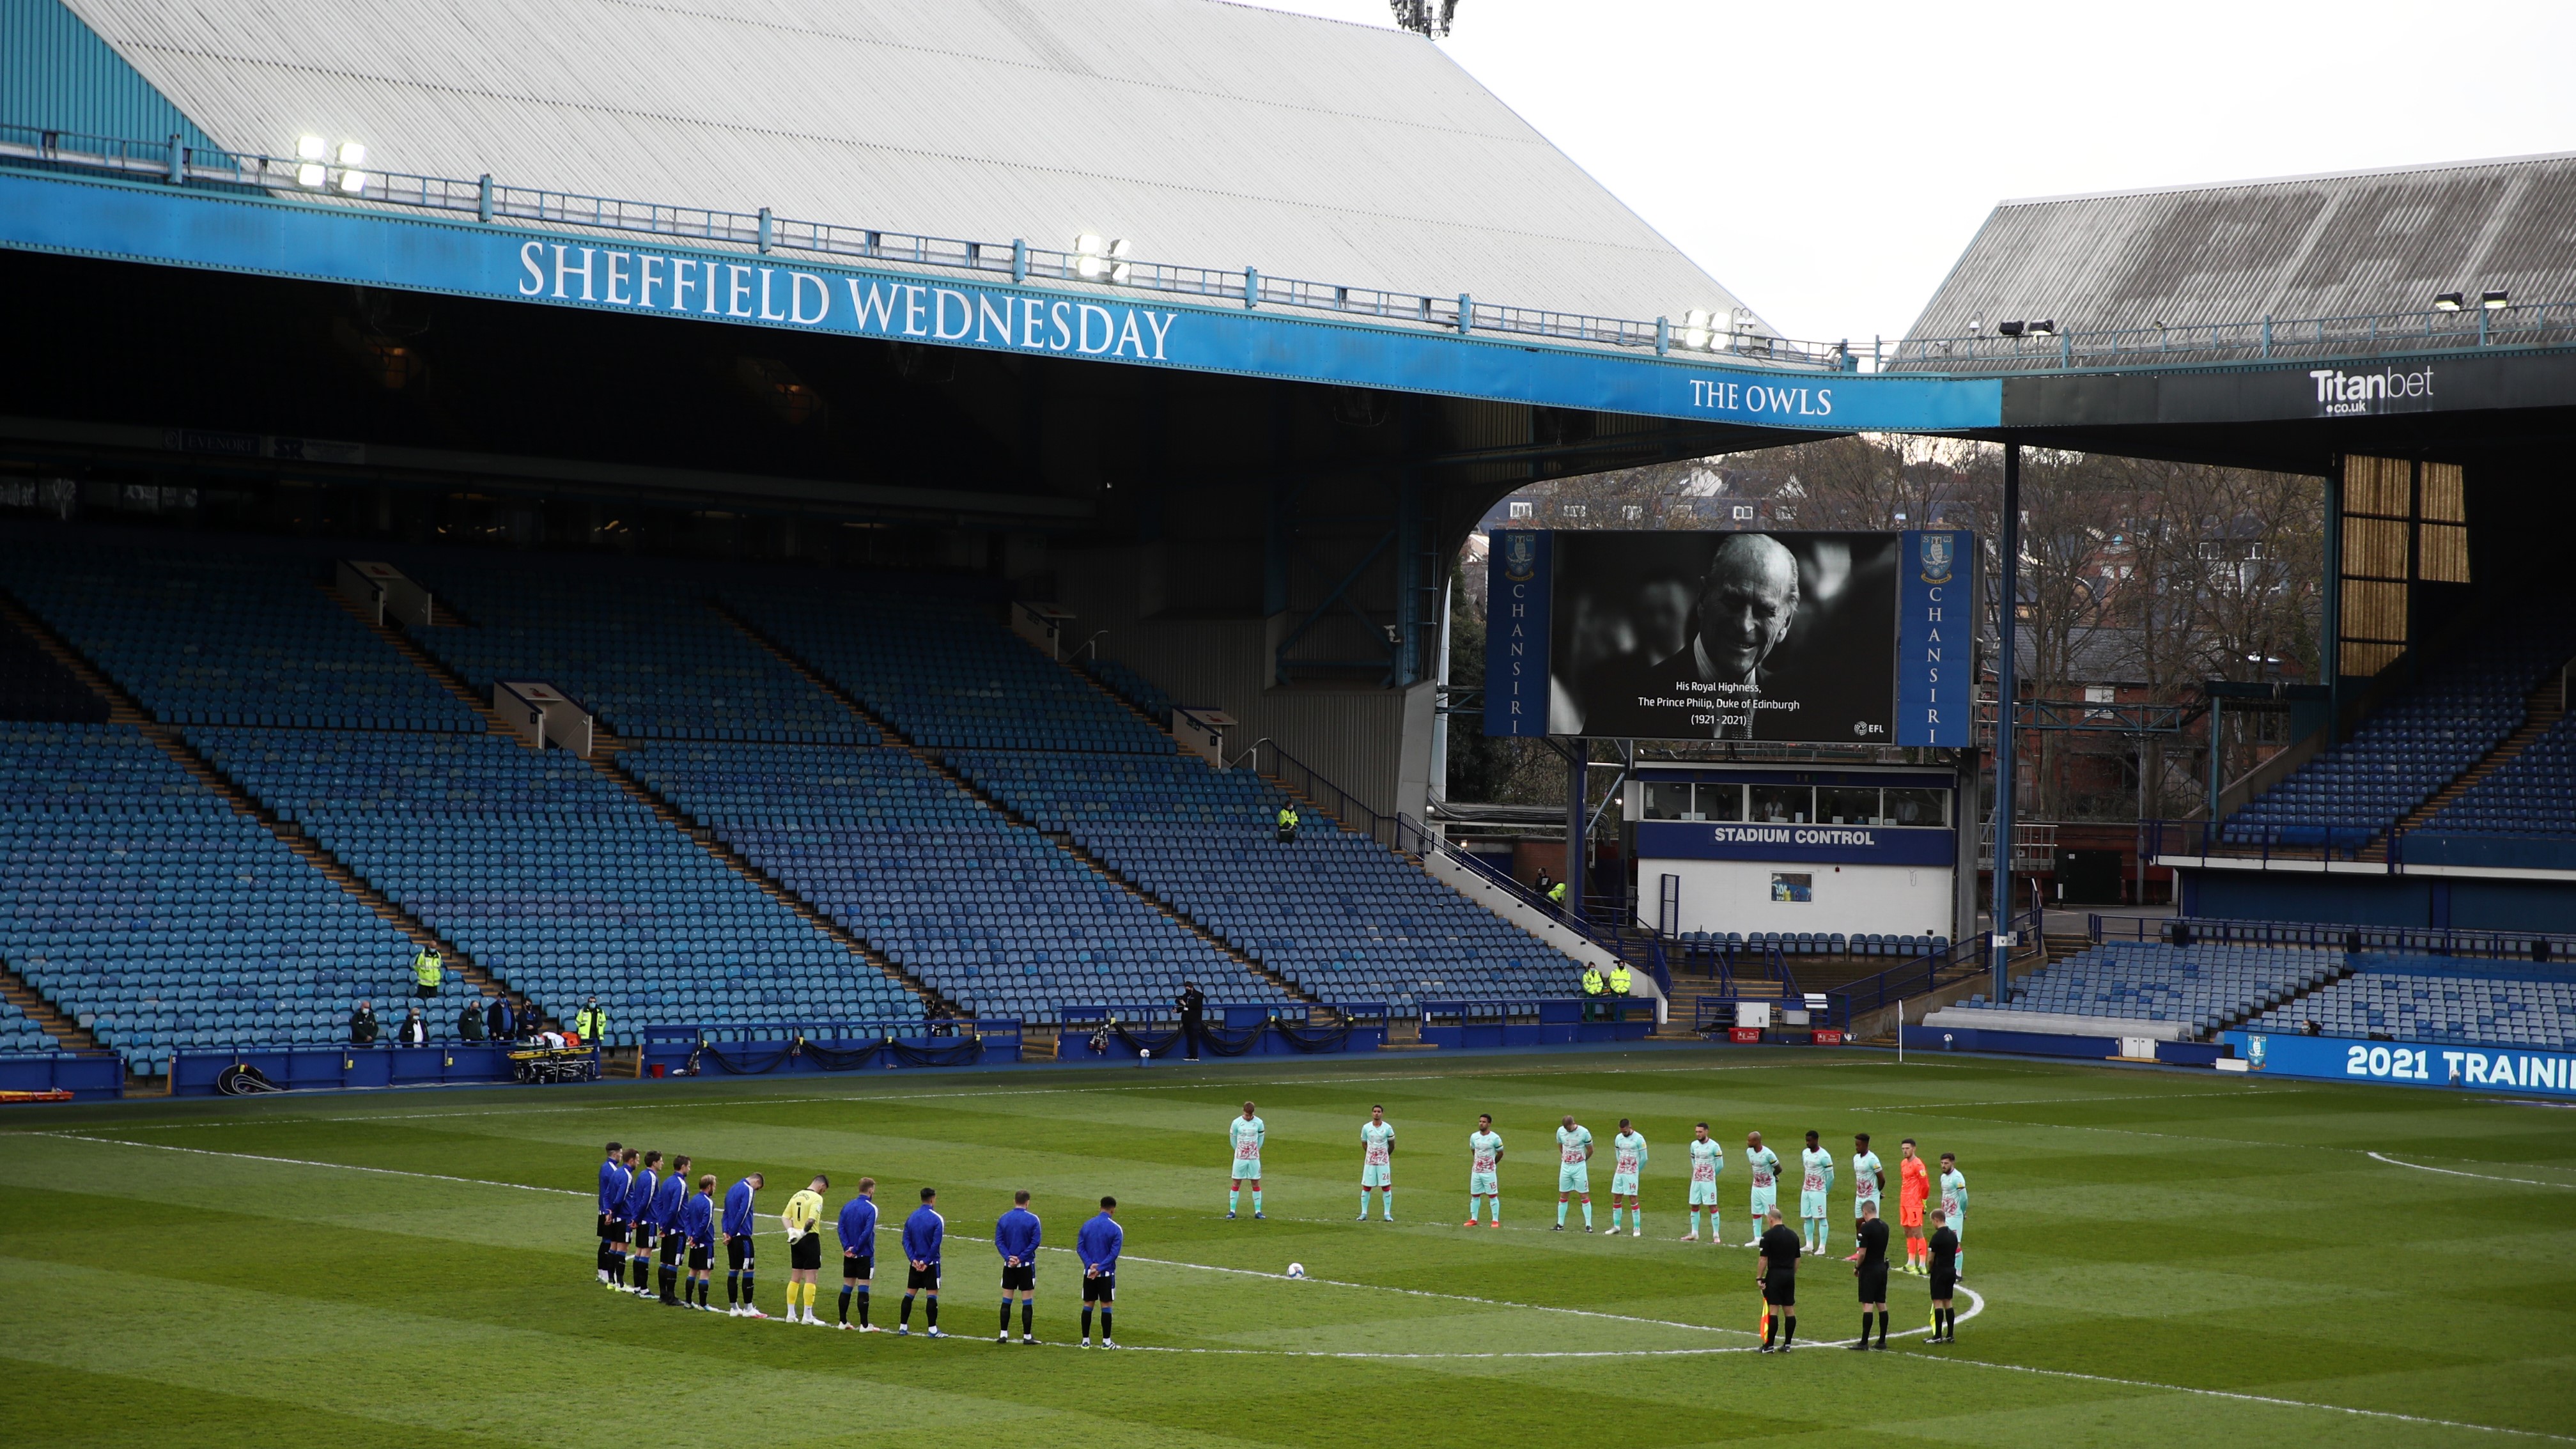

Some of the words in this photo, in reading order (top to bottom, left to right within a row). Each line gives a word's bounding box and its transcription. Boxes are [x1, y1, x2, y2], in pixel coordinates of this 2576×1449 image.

[518, 240, 829, 325] SHEFFIELD
[846, 277, 1177, 360] WEDNESDAY
[2309, 365, 2434, 402] Titanbet
[1689, 379, 1739, 410] THE
[1746, 385, 1832, 415] OWLS
[189, 435, 254, 452] EVENORT
[1676, 681, 1690, 692] His
[1691, 682, 1716, 694] Royal
[1718, 682, 1762, 694] Highness,
[1638, 697, 1654, 707] The
[1657, 697, 1685, 708] Prince
[1687, 698, 1714, 709] Philip,
[1716, 699, 1739, 709] Duke
[1741, 699, 1751, 709] of
[1753, 699, 1800, 711] Edinburgh
[1691, 715, 1714, 726] (1921
[1721, 715, 1747, 726] 2021)
[1868, 724, 1884, 734] EFL
[1715, 828, 1790, 843] STADIUM
[1795, 830, 1875, 845] CONTROL
[2347, 1045, 2428, 1079] 2021
[2442, 1051, 2576, 1090] TRAINI
